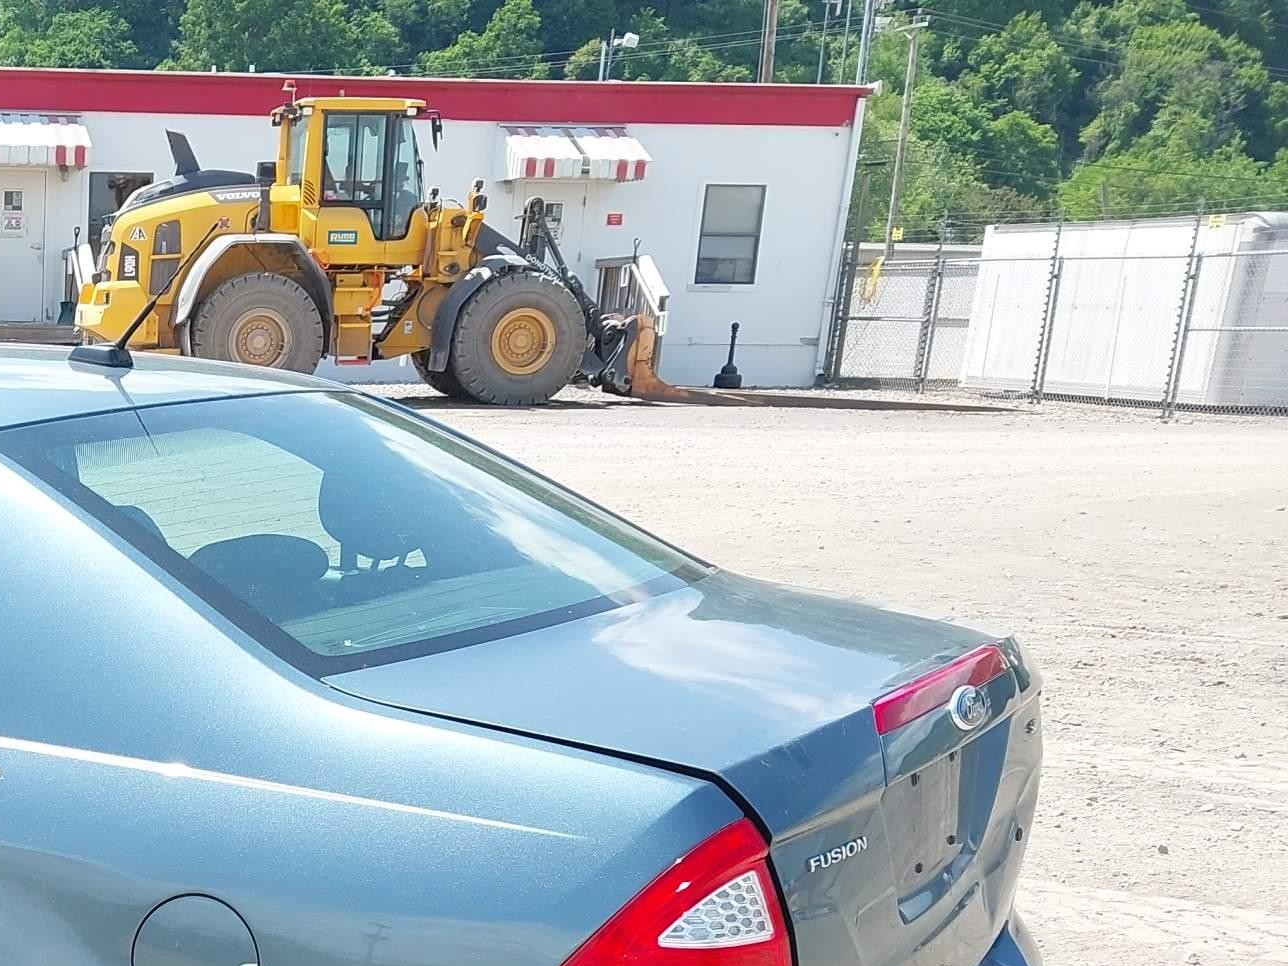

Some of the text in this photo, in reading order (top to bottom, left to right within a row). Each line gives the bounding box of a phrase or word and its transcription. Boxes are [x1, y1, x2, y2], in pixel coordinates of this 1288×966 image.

[215, 191, 260, 201] VOLVO
[124, 255, 136, 277] L90H
[808, 835, 868, 873] FUSION
